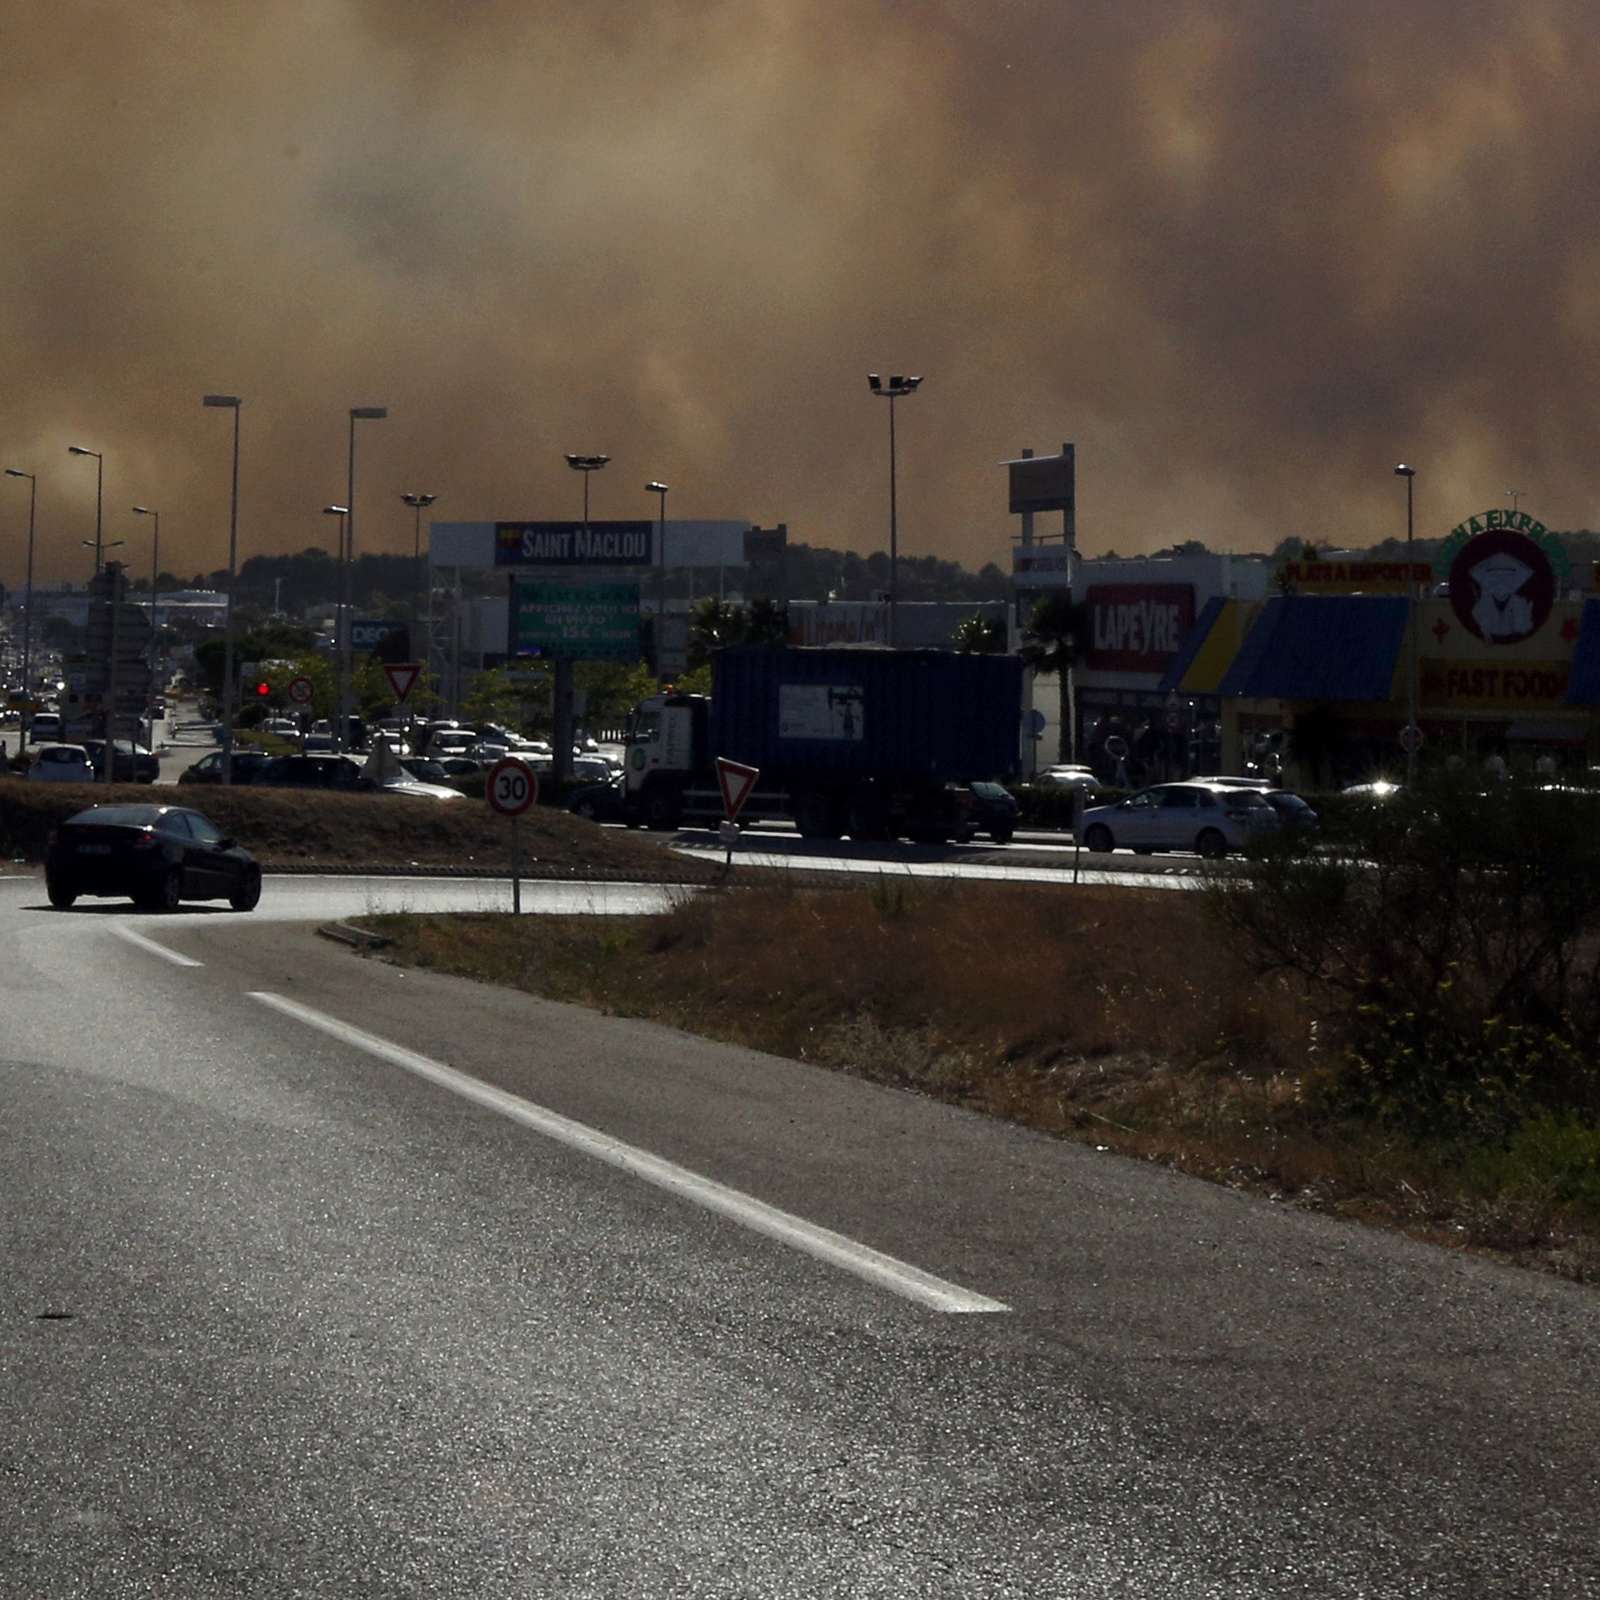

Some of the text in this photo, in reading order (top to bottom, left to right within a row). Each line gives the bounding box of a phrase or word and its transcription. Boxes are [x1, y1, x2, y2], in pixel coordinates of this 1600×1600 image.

[521, 528, 646, 558] SAINT MACLOU
[1093, 601, 1179, 654] LAPEYRE
[1448, 667, 1499, 698] FAST
[499, 776, 525, 800] 30
